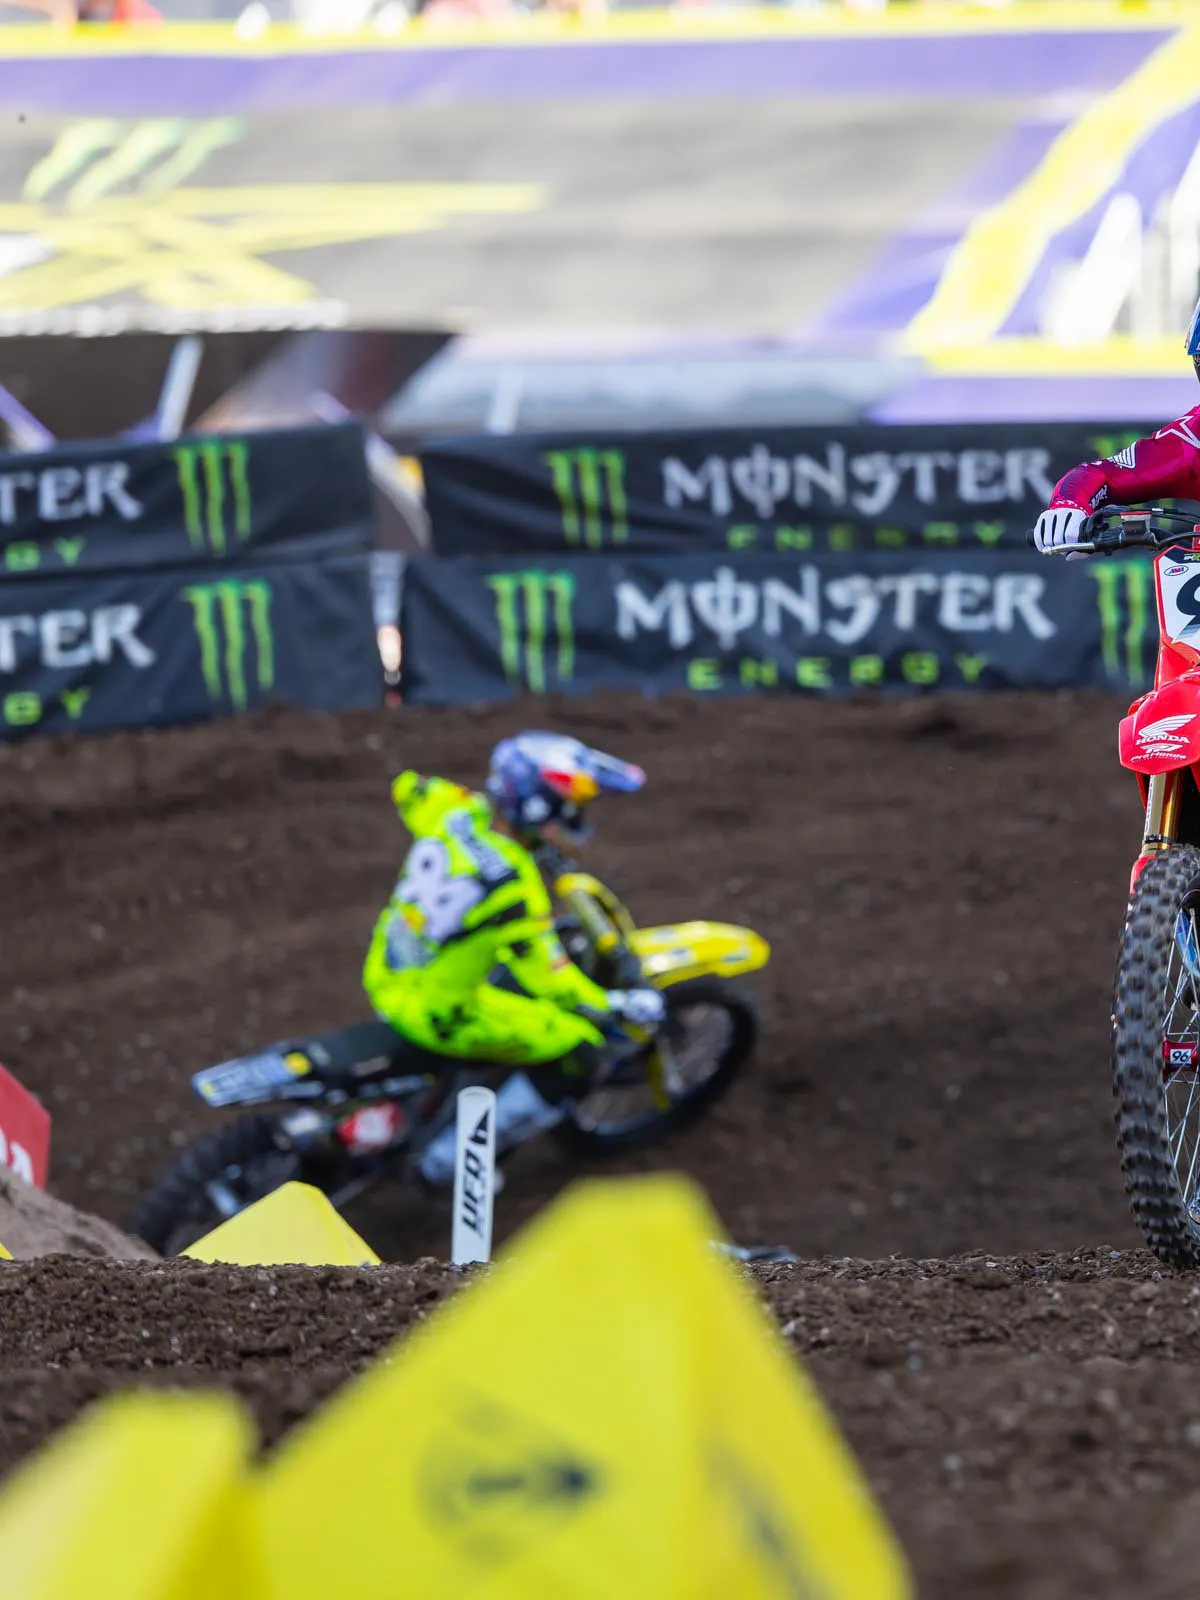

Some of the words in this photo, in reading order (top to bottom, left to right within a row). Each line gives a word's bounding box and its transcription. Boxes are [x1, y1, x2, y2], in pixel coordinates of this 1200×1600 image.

[661, 442, 1058, 518] MONSTER
[615, 565, 1057, 651] MONSTER
[687, 653, 988, 690] ENERGY
[1135, 734, 1190, 745] HONDA
[1171, 1051, 1190, 1062] 96
